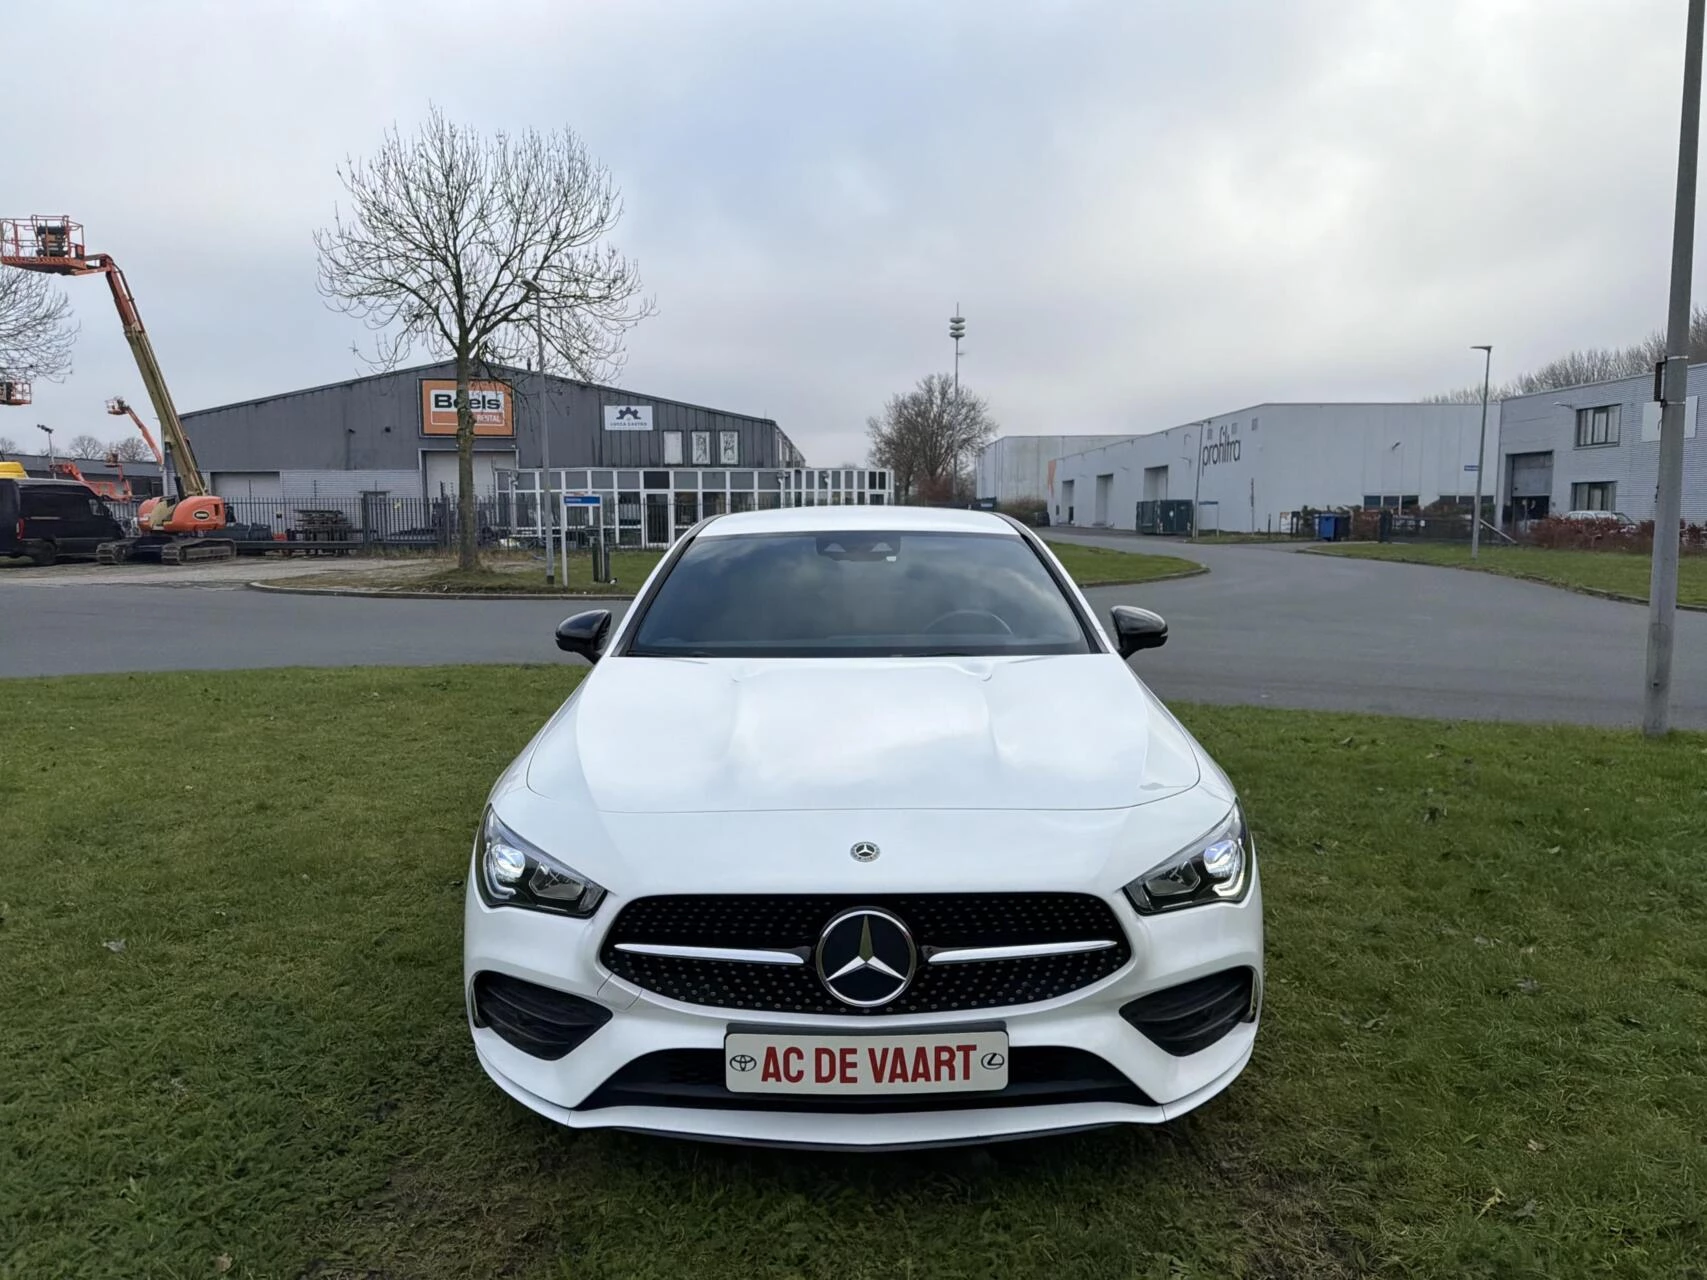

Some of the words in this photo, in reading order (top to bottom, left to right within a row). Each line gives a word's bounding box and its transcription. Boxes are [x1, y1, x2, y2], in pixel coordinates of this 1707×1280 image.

[1202, 425, 1241, 476] profiltra
[761, 1046, 804, 1083] AC
[814, 1047, 858, 1083] DE
[867, 1044, 977, 1083] VAART
